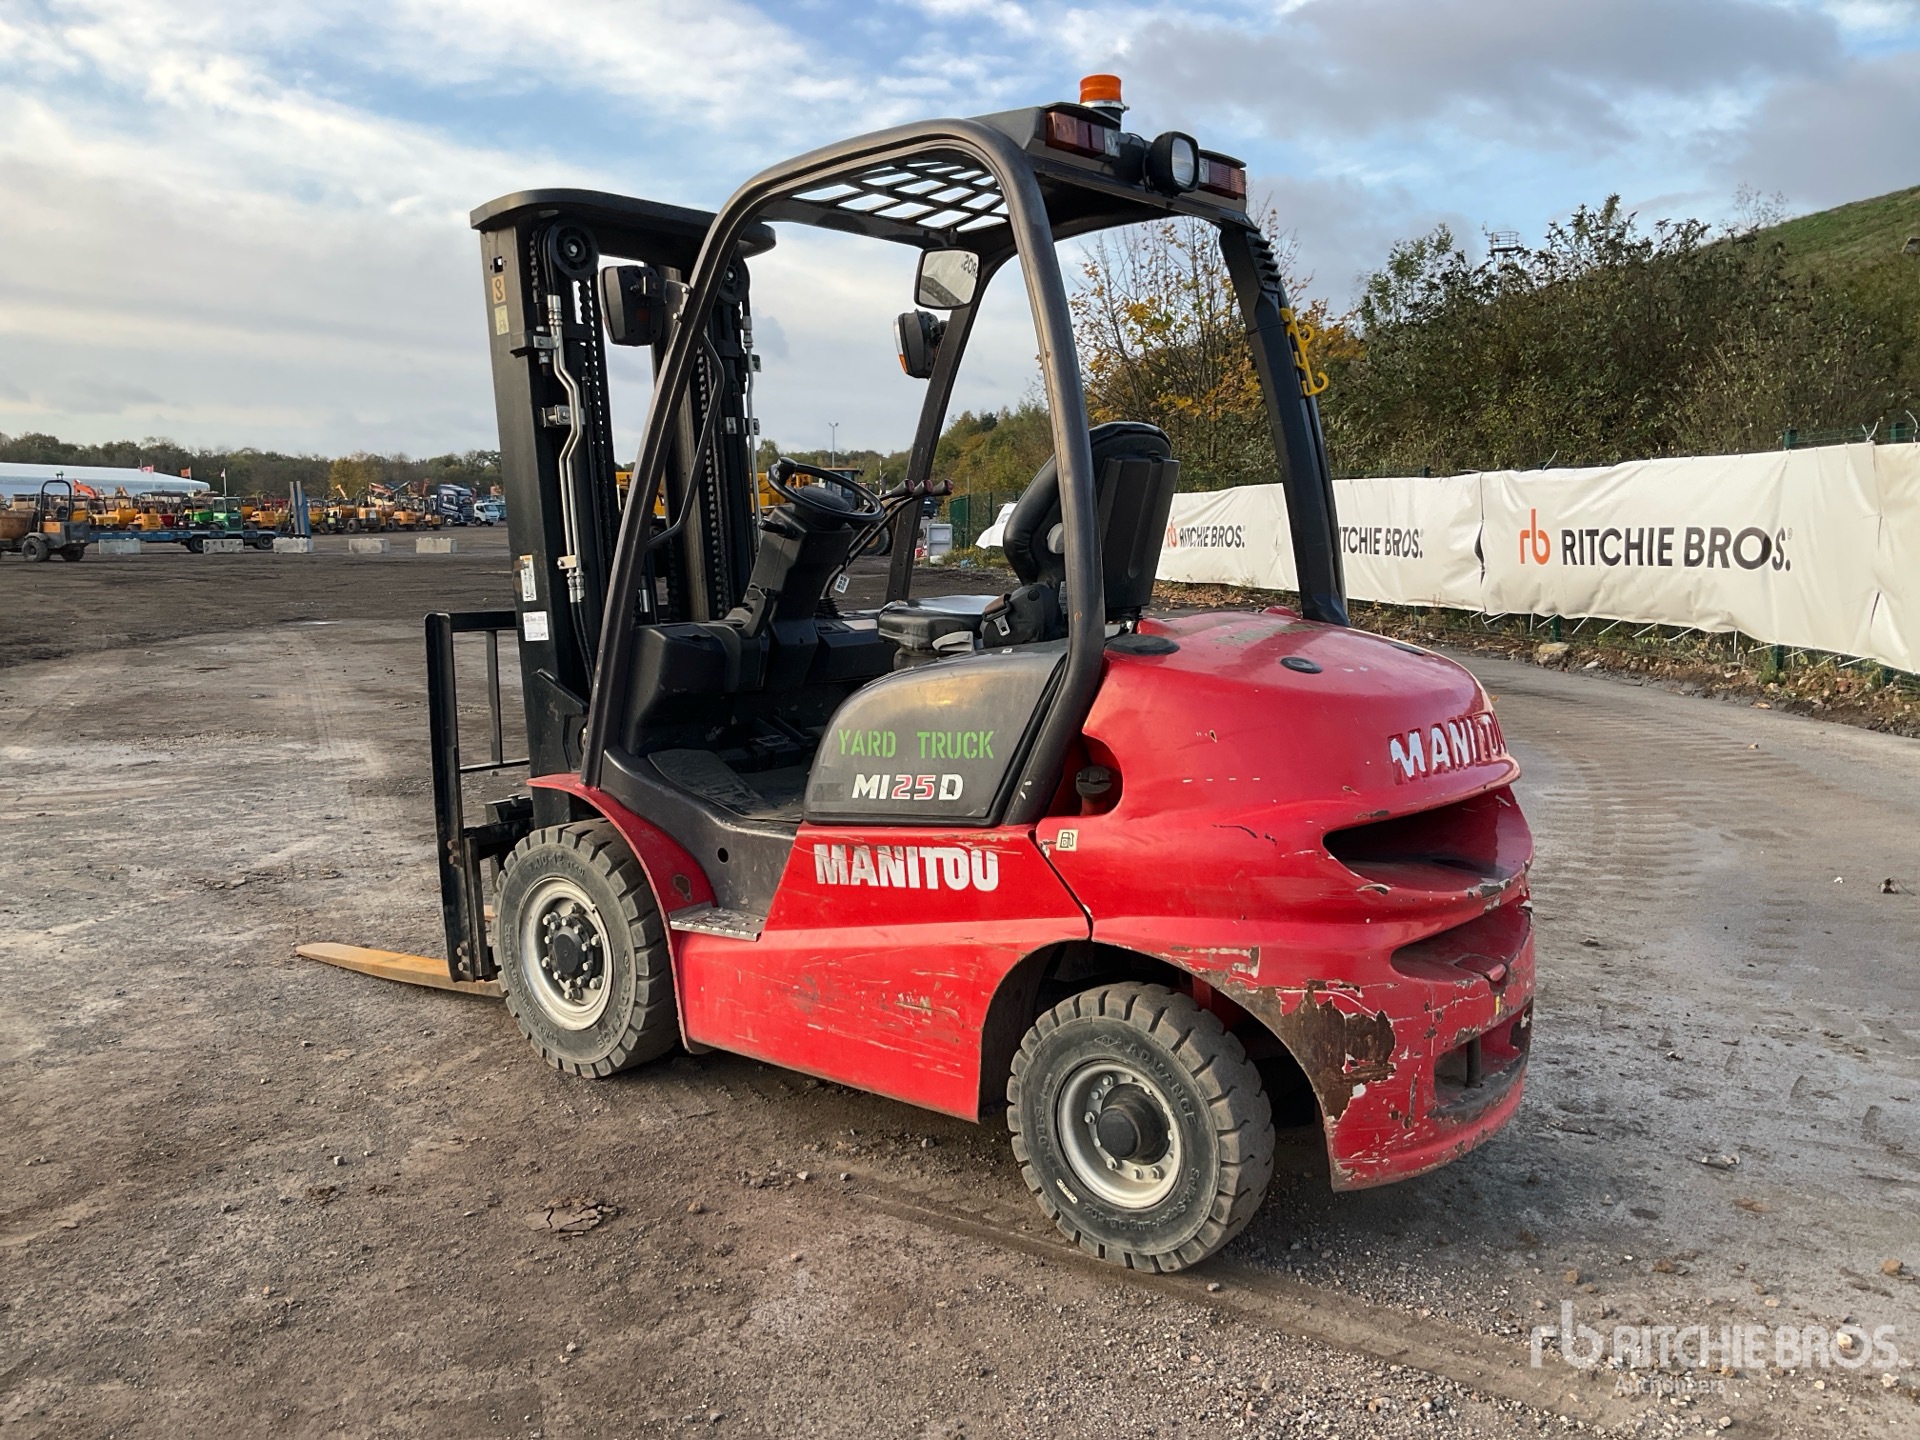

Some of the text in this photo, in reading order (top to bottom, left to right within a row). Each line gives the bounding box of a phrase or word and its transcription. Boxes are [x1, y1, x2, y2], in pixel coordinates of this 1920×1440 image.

[1561, 527, 1674, 566] RITCHIE
[838, 729, 995, 759] YARD TRUCK
[851, 774, 964, 800] MI25D
[814, 844, 999, 891] MANITOU
